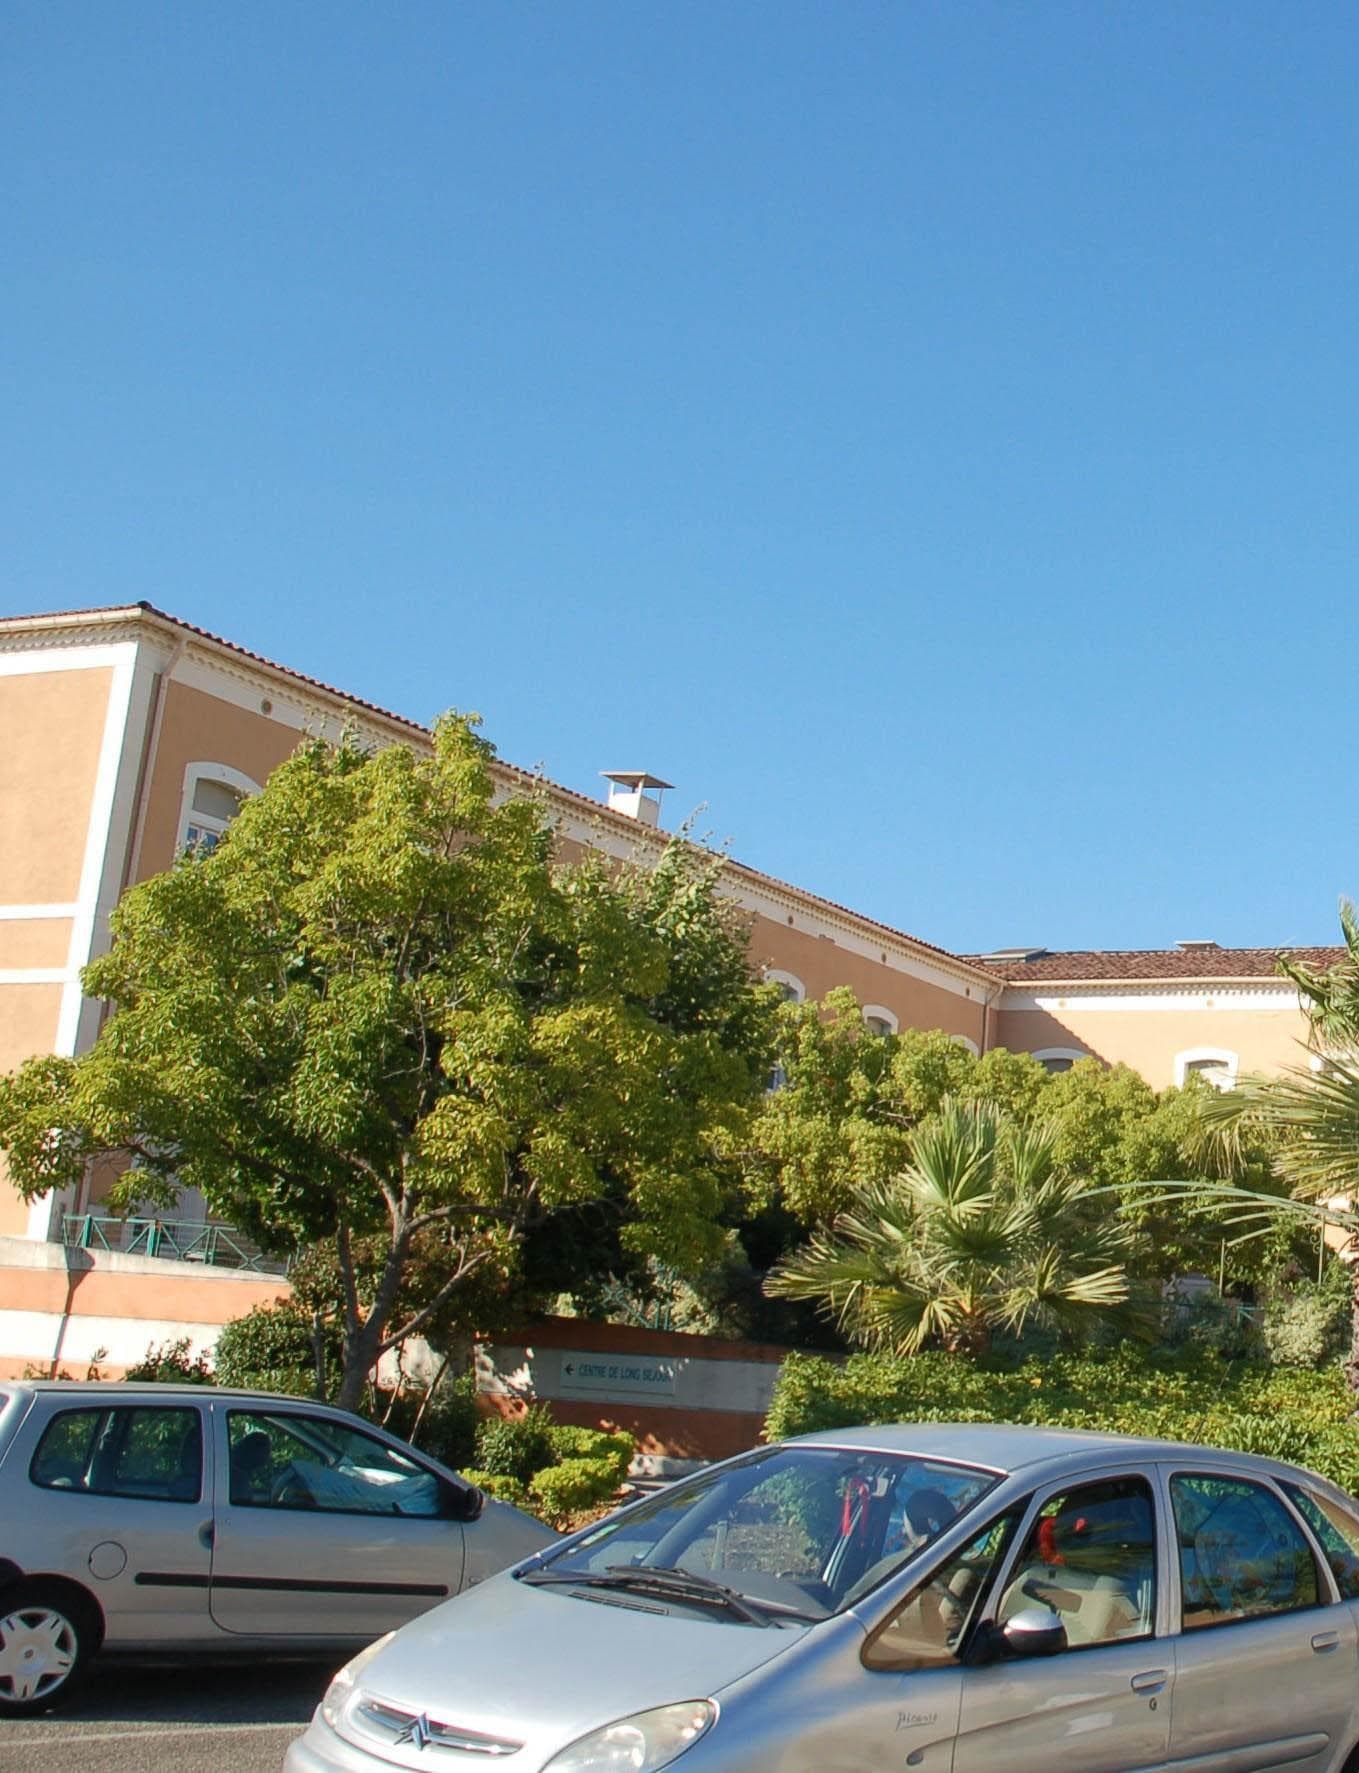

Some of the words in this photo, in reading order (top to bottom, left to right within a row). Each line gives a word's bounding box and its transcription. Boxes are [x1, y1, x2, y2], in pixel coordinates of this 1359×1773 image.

[579, 1363, 606, 1379] CENTRE
[608, 1365, 618, 1379] DE
[620, 1366, 641, 1381] LONG
